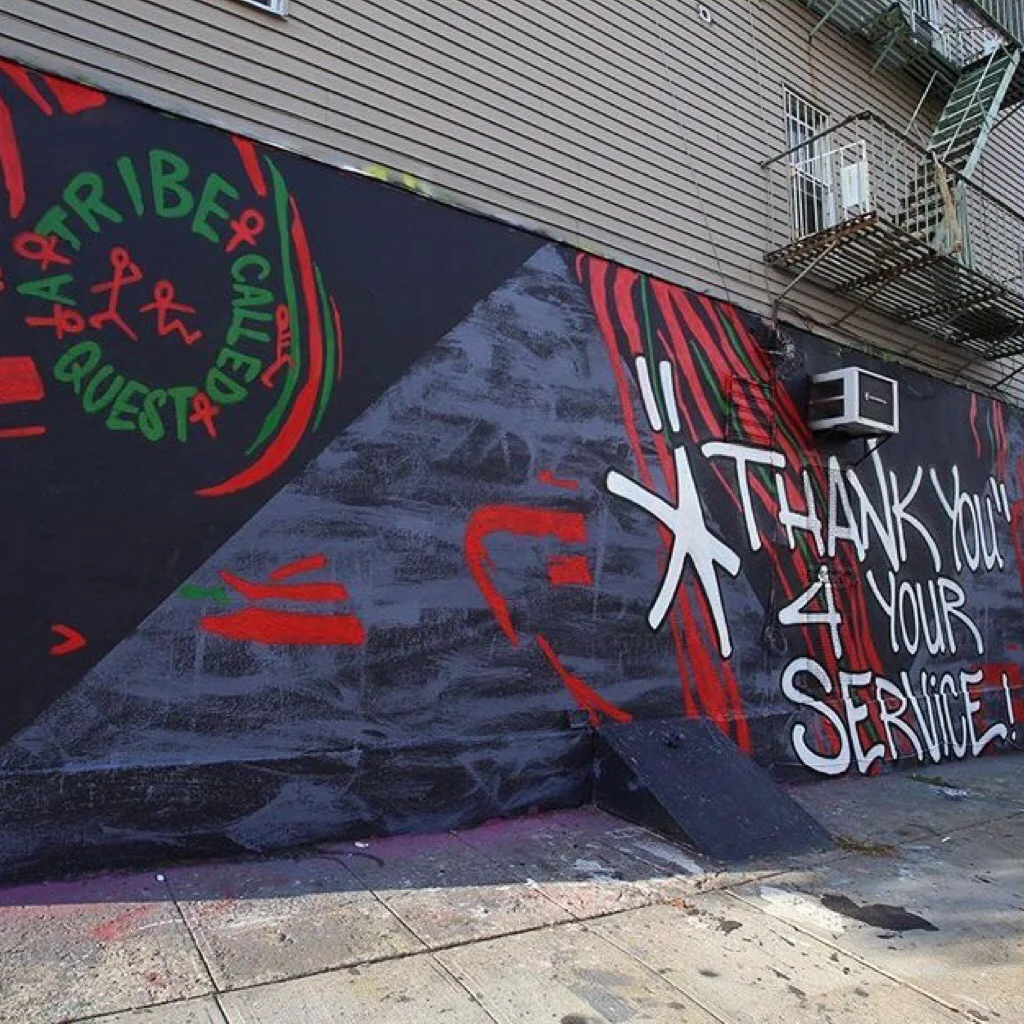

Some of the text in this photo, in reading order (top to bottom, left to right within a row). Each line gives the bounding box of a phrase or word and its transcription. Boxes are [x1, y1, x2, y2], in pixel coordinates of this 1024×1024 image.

[16, 148, 275, 443] A TRIBE CALLED QUEST
[778, 566, 842, 660] 4
